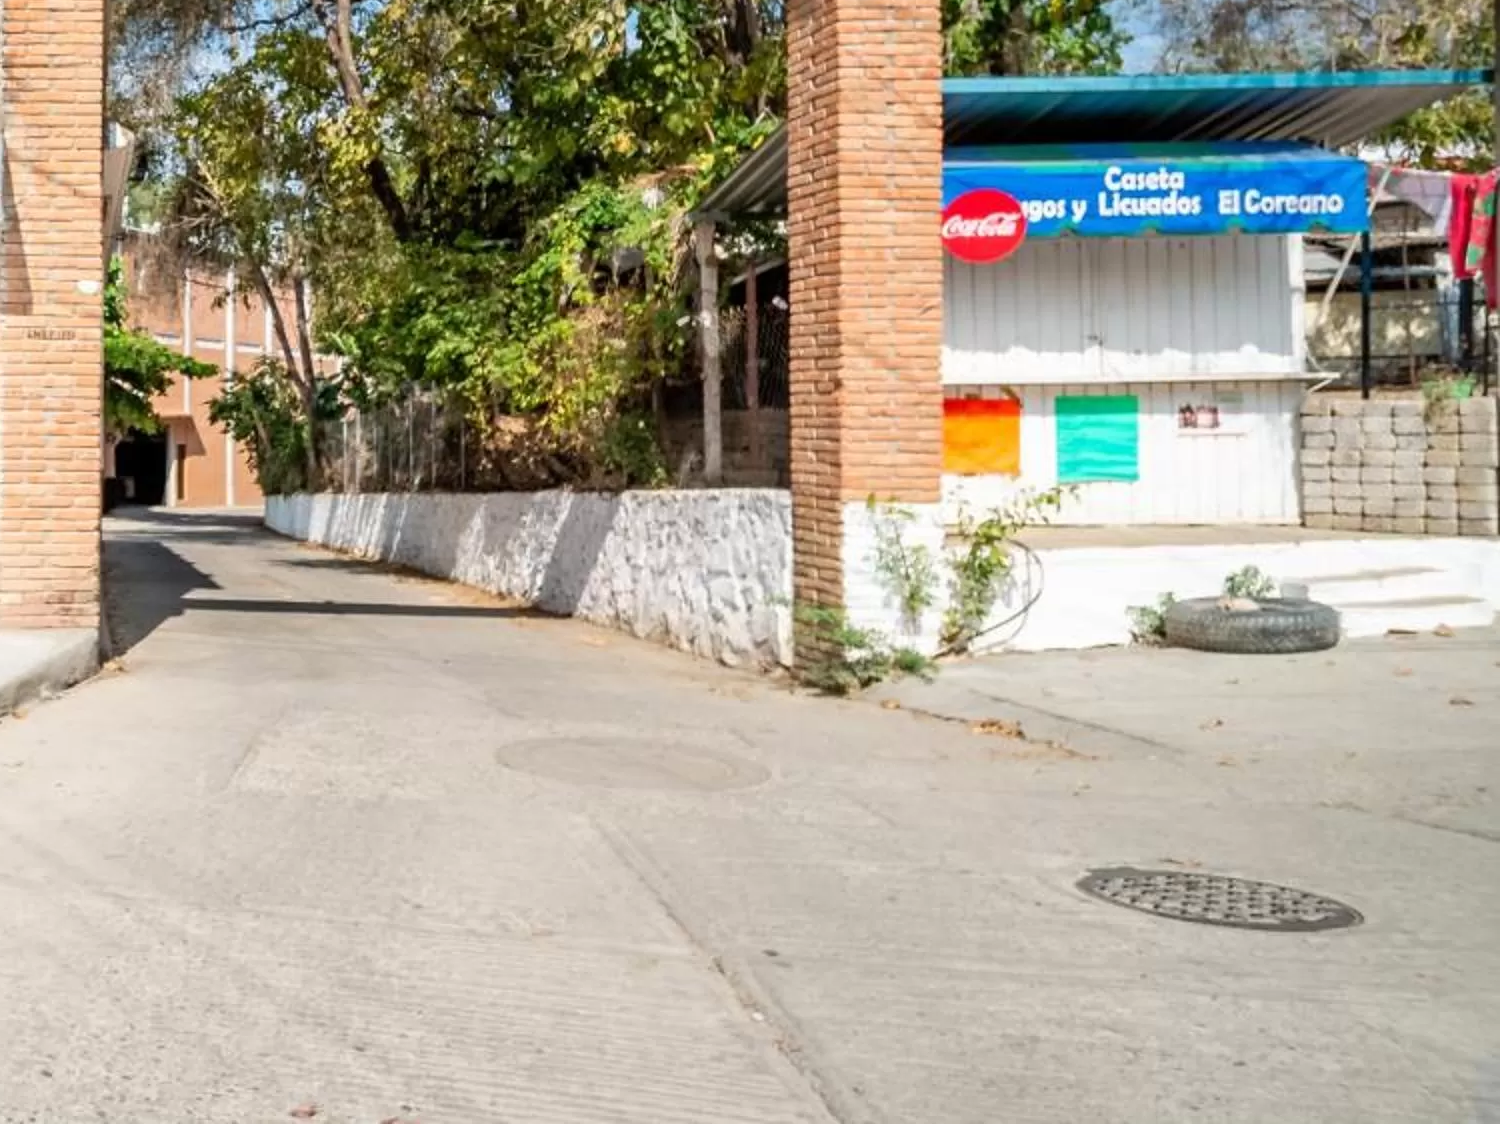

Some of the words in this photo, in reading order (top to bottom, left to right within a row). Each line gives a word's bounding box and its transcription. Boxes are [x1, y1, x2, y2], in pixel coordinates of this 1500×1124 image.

[1103, 166, 1186, 191] Caseta
[1071, 199, 1088, 223] y
[1098, 190, 1202, 217] Licuados
[1218, 189, 1241, 215] El
[1244, 188, 1345, 215] Coreano
[941, 212, 1022, 239] Coca-Cola
